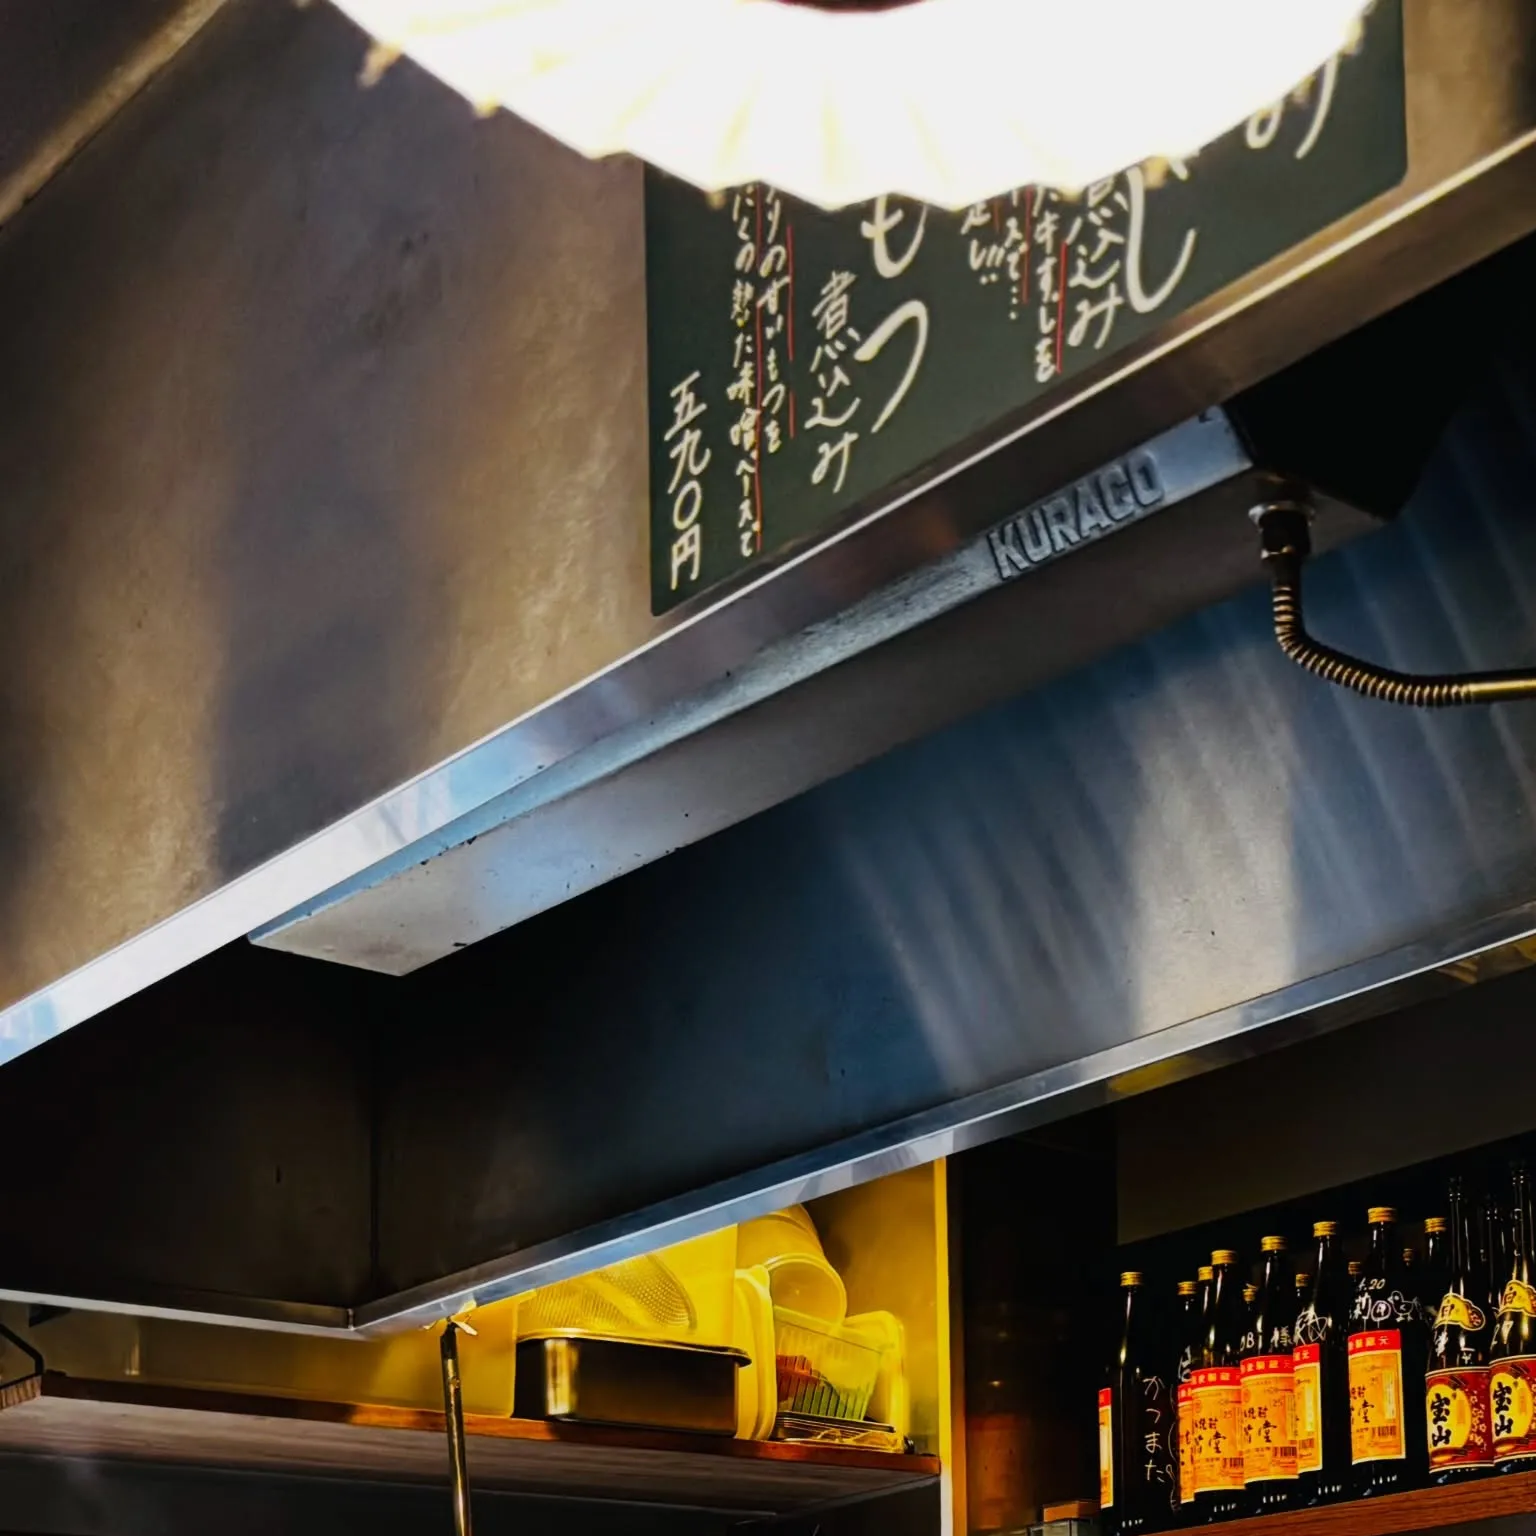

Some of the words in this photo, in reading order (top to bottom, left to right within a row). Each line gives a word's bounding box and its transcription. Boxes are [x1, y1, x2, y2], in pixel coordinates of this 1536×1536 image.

[804, 269, 861, 494] 煮込み
[1142, 1375, 1166, 1483] かつまた
[1430, 1393, 1452, 1448] 宝山
[1492, 1381, 1514, 1438] 宝山
